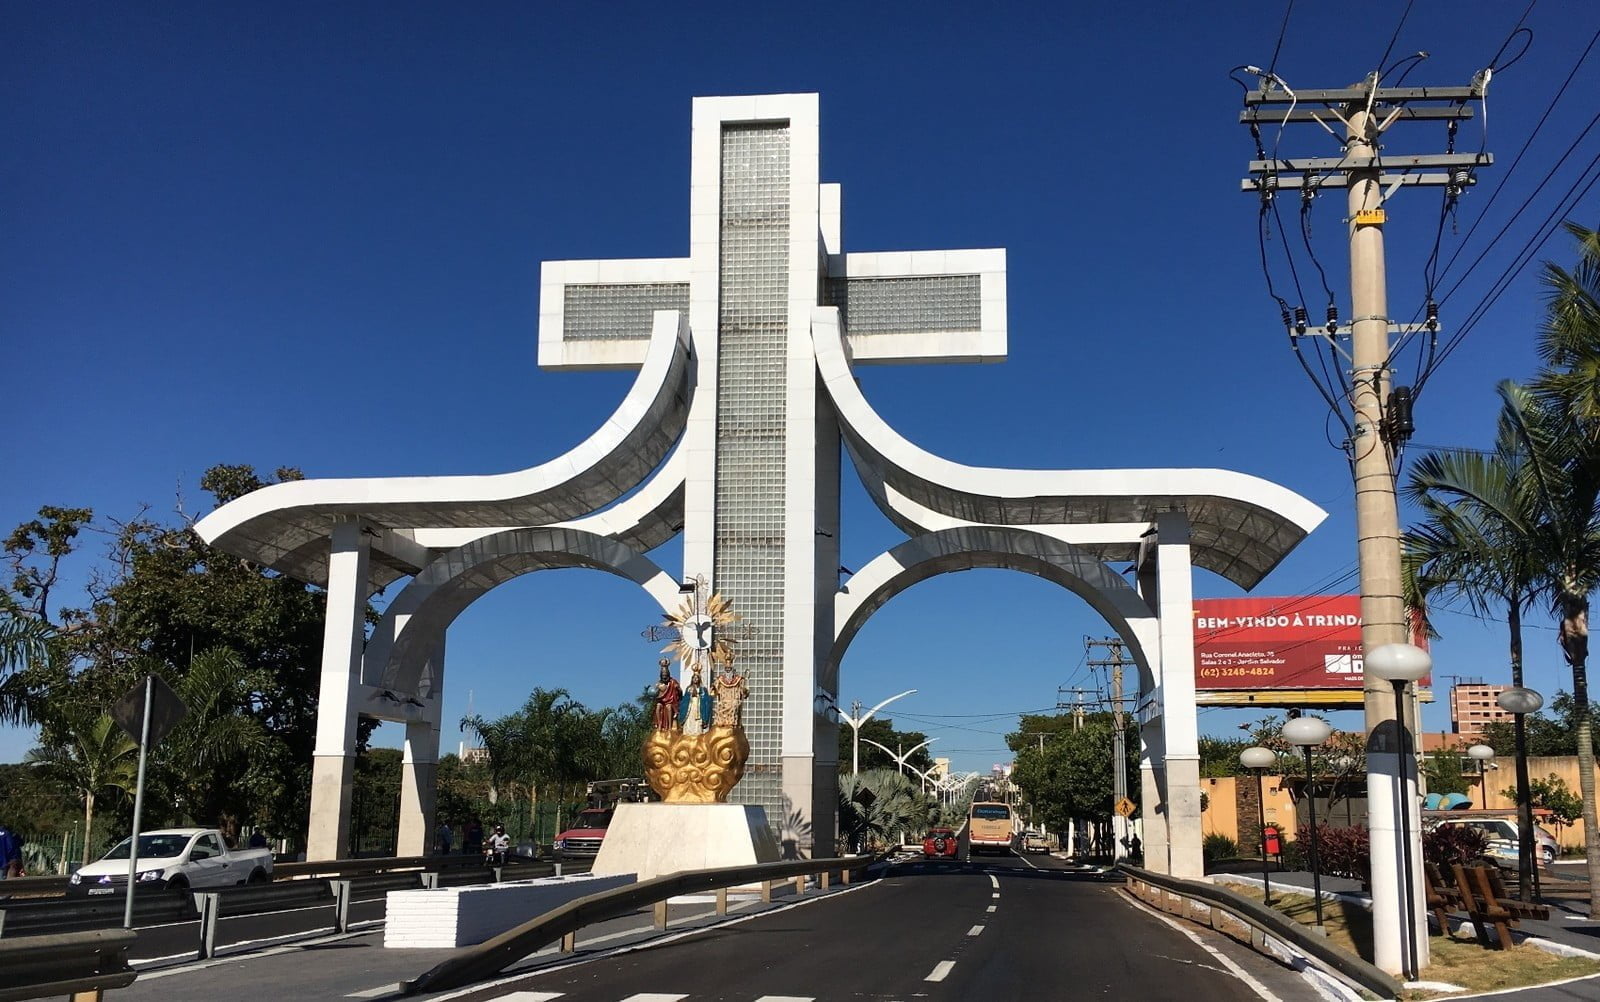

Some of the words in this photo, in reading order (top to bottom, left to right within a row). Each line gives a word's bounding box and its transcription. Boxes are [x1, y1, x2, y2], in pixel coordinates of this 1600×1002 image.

[1197, 616, 1289, 629] BEM-VINDO
[1292, 612, 1305, 627] À
[1200, 668, 1220, 678] (62)
[1221, 667, 1275, 677] 3248-4824
